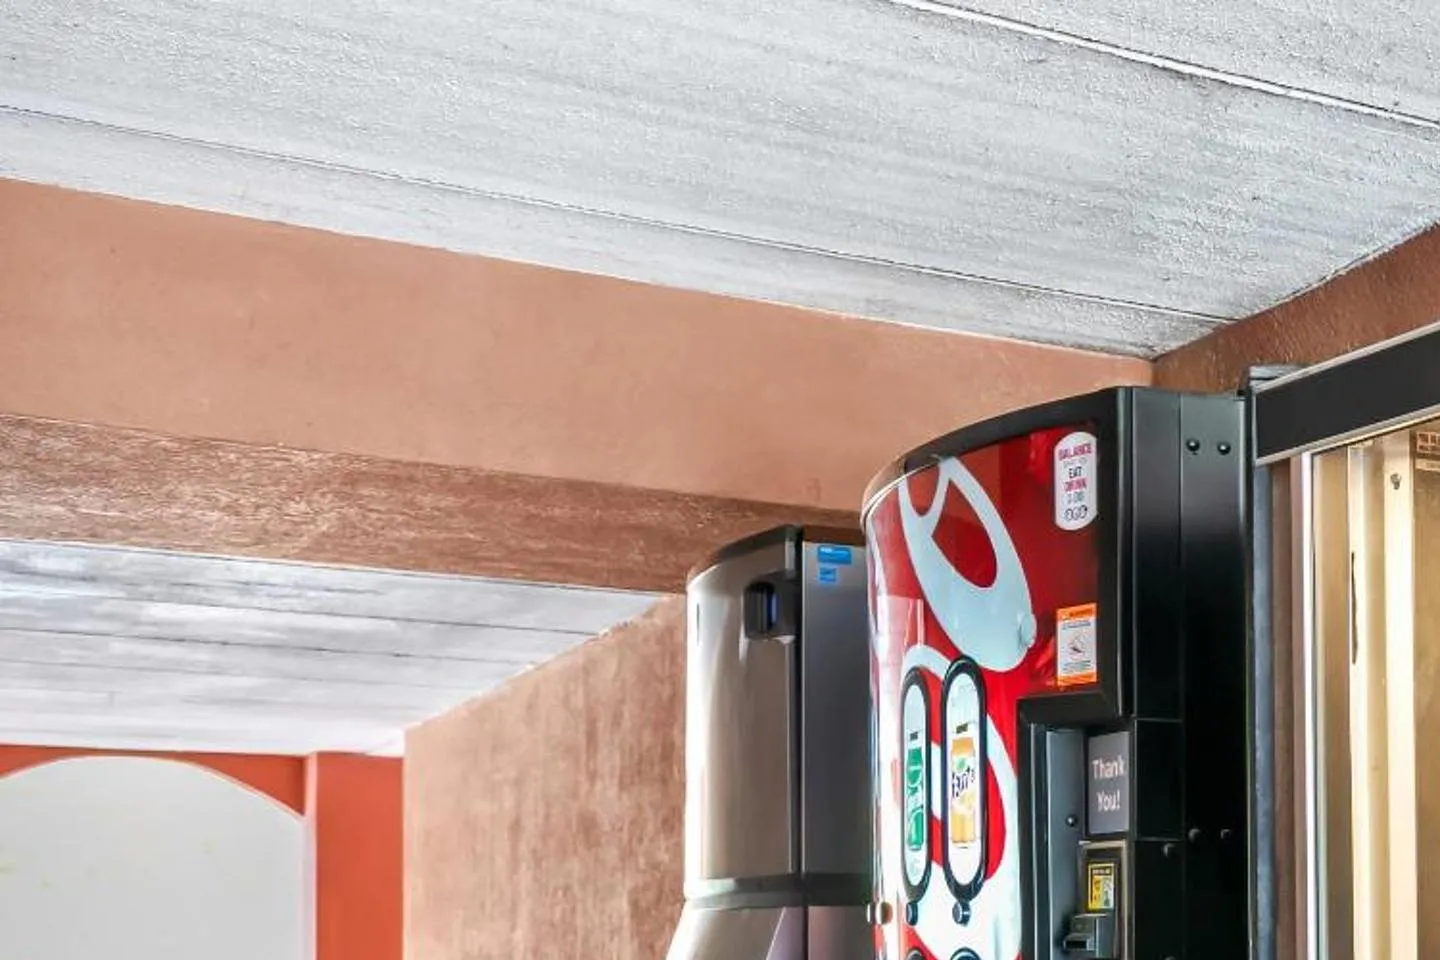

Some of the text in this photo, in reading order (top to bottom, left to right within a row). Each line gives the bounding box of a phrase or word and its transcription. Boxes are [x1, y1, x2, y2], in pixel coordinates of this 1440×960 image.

[1059, 444, 1092, 461] BALANCE
[1068, 466, 1082, 478] EAT
[1092, 754, 1125, 779] Thank
[1096, 789, 1120, 812] You!
